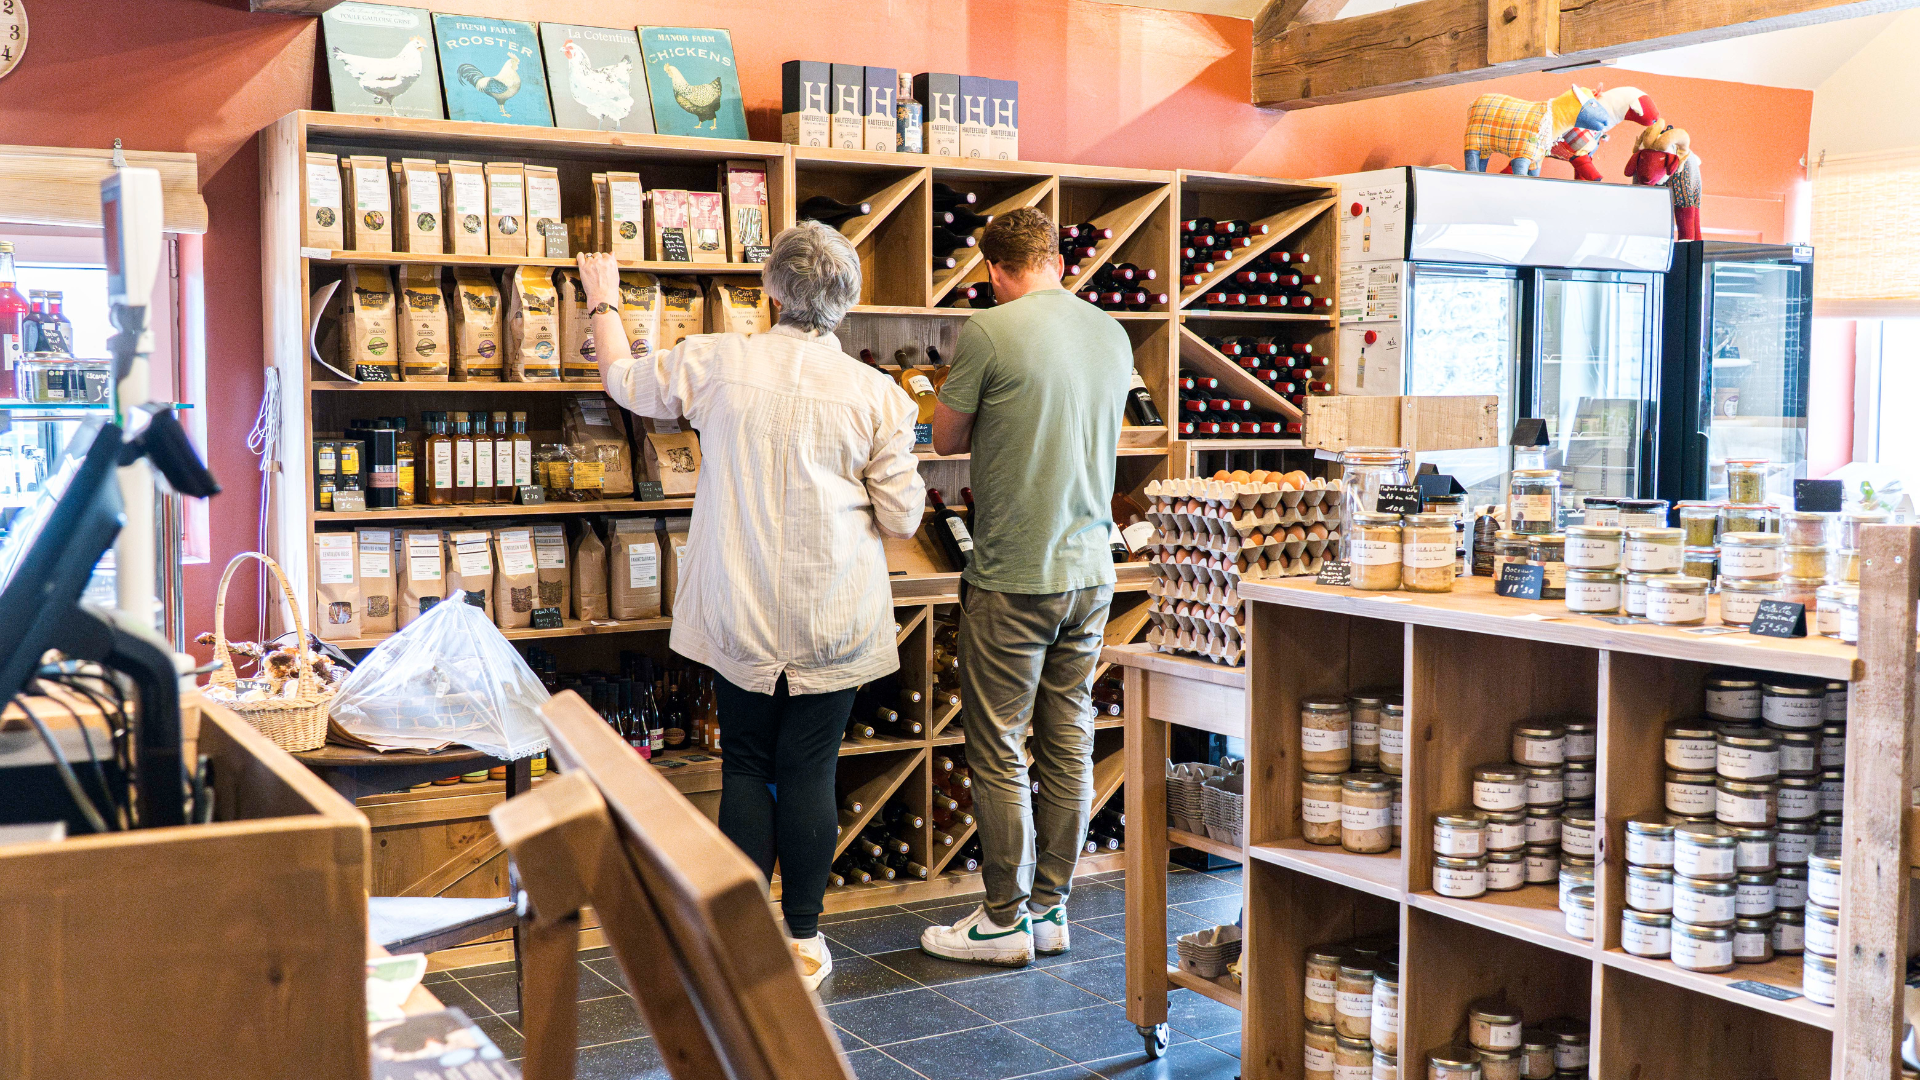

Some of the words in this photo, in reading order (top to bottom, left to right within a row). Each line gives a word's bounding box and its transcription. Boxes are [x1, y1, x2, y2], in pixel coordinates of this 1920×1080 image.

[3, 0, 14, 15] 2
[340, 13, 360, 21] POULE
[10, 24, 20, 40] 3
[456, 22, 486, 33] FRESH
[490, 26, 517, 35] FARM
[568, 29, 582, 39] La
[584, 31, 637, 45] Cotentine
[657, 34, 690, 43] MANOR
[692, 35, 715, 43] FARM
[1, 44, 12, 61] 4
[446, 36, 534, 59] ROOSTER
[648, 47, 732, 68] CHICKENS
[802, 81, 829, 114] H
[835, 84, 862, 116] H
[868, 86, 895, 117] H
[931, 92, 957, 122] H
[962, 95, 988, 125] H
[991, 98, 1017, 128] H
[801, 114, 829, 123] HAUTEFEUILLE
[867, 118, 895, 127] HAUTEFEUILLE
[630, 286, 650, 296] Café
[673, 290, 690, 298] Café
